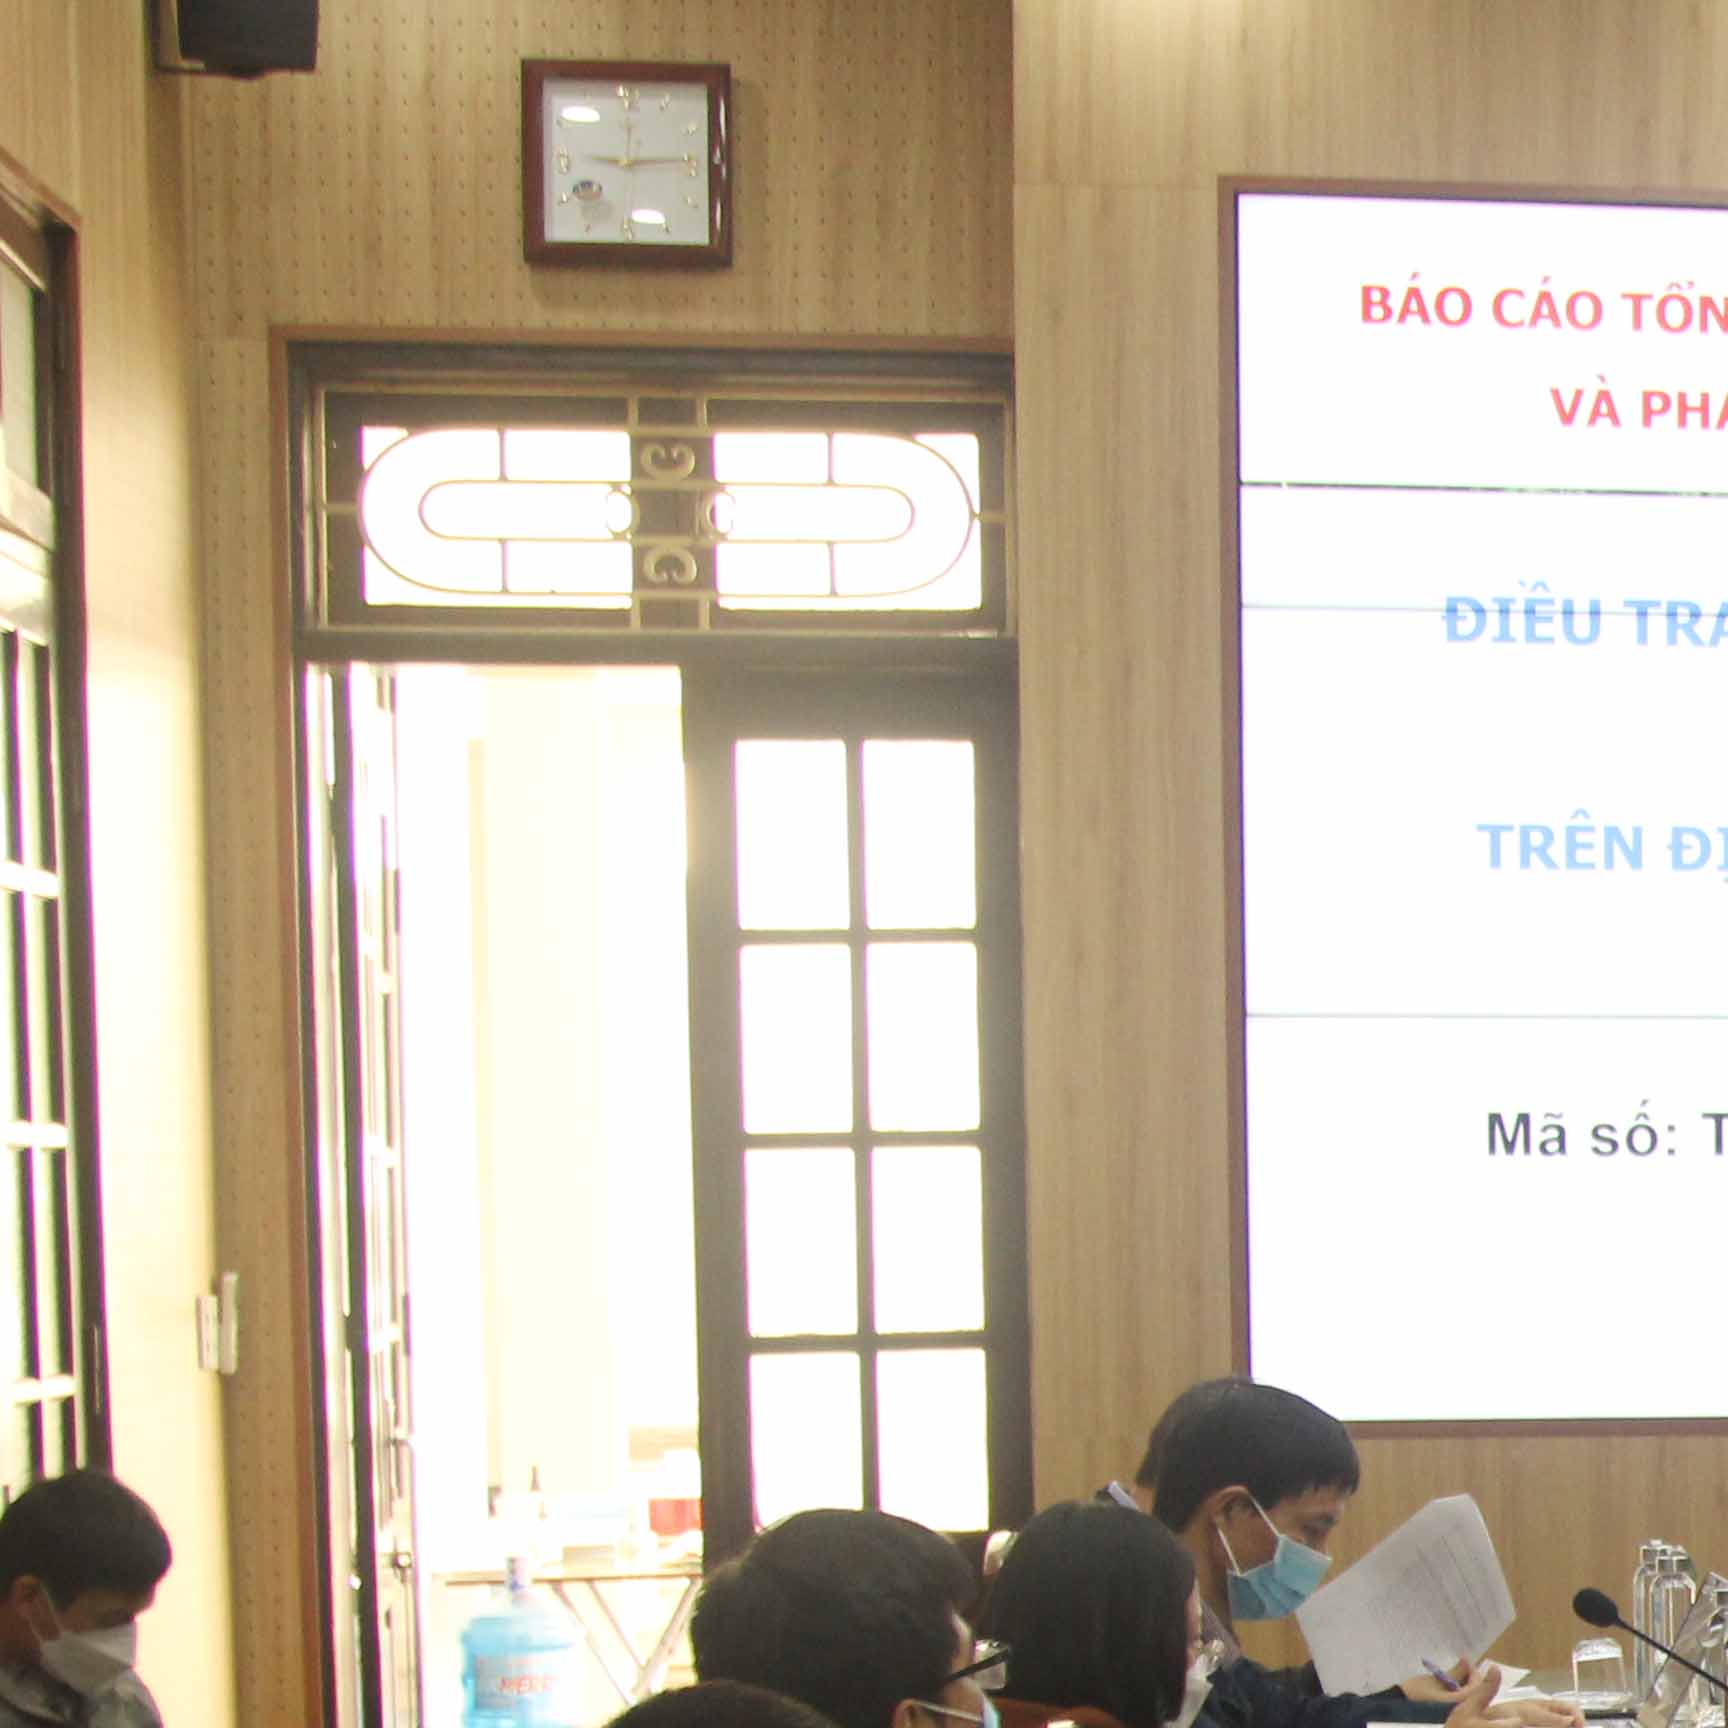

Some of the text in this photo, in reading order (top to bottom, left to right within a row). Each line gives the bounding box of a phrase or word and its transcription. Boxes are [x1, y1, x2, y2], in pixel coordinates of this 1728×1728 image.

[1361, 272, 1473, 328] BÁO
[1492, 276, 1604, 332] CÁO
[1551, 374, 1621, 428] VÀ
[1441, 579, 1601, 646] ĐIỀU
[1475, 808, 1643, 871] TRÊN
[1488, 1112, 1566, 1156] Mã
[1591, 1099, 1675, 1157] số:
